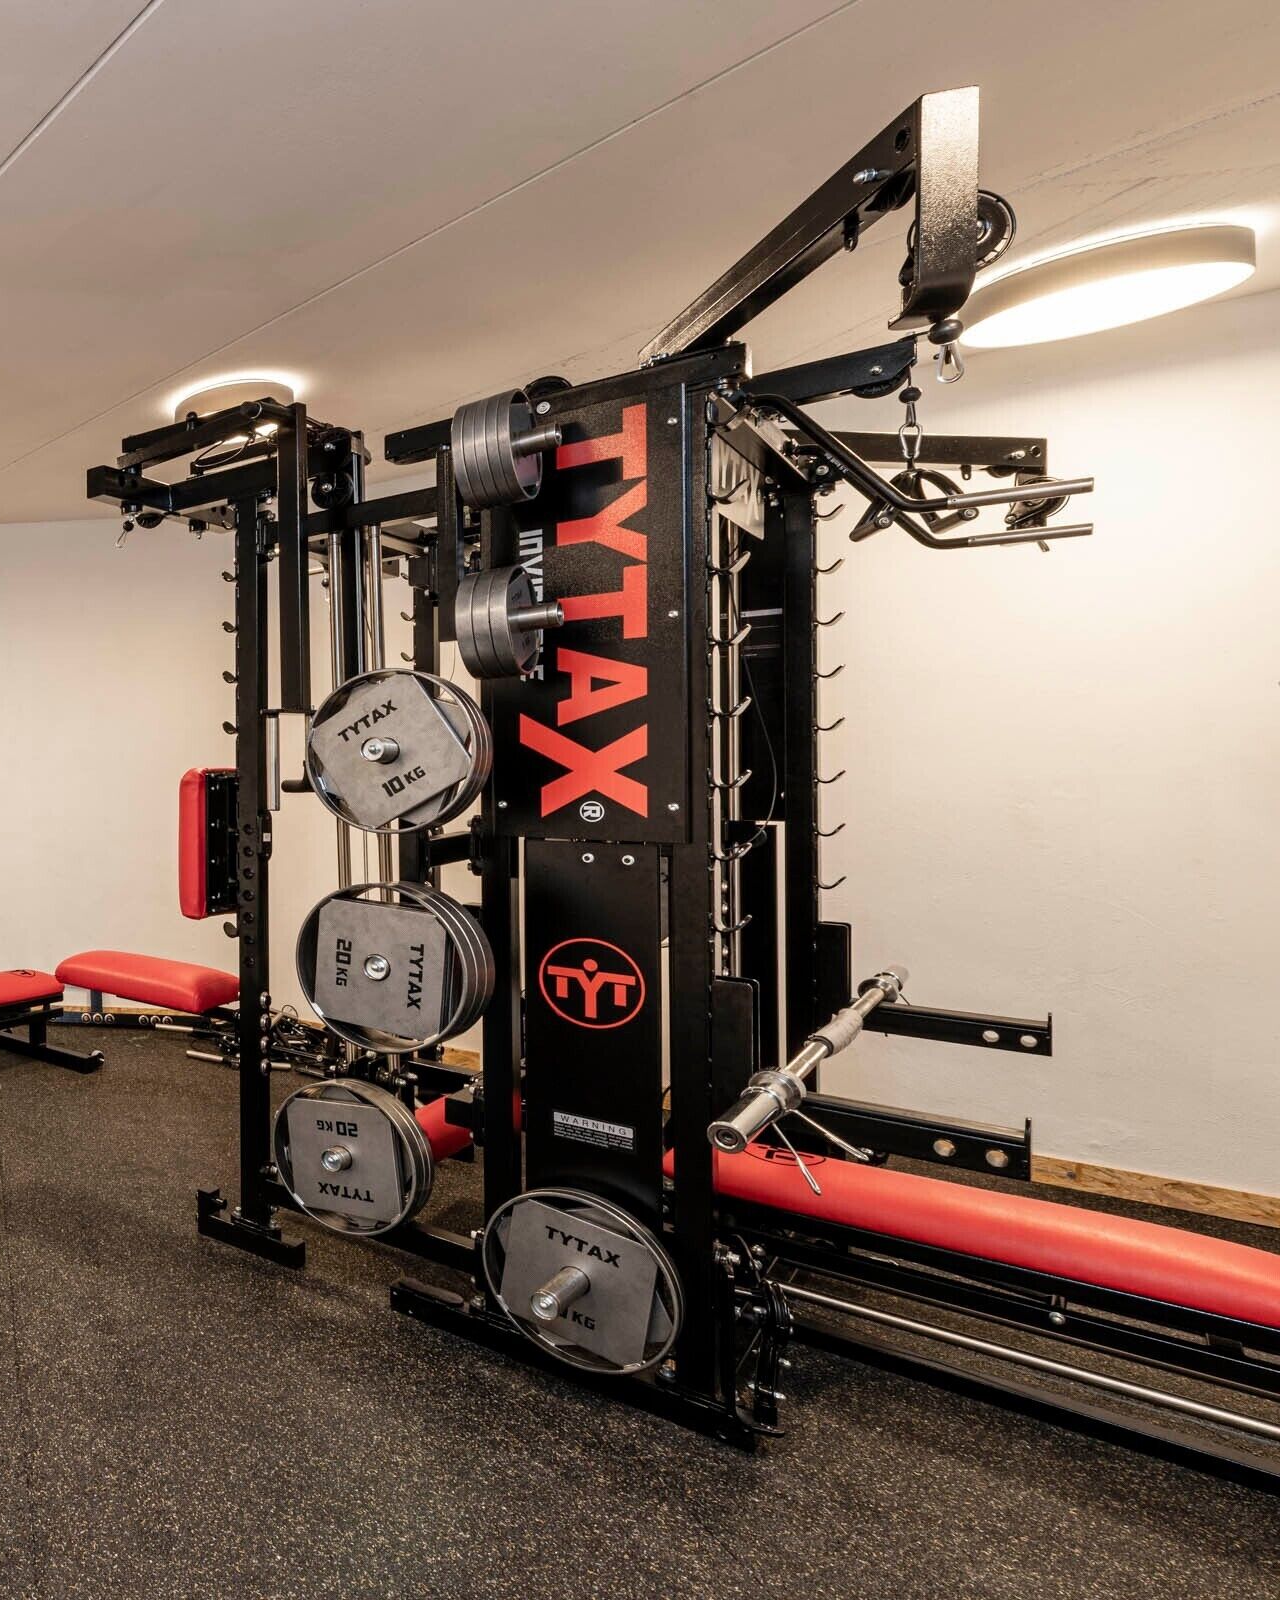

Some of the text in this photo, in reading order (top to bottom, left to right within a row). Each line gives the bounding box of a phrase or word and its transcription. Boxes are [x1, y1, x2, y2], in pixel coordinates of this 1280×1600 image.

[720, 439, 760, 526] YTAX
[337, 699, 398, 742] TYTAX
[382, 766, 426, 797] 10 KG
[335, 938, 352, 987] 20 KG
[407, 944, 425, 1010] TYTAX
[316, 1120, 358, 1137] 20 KG
[560, 1114, 627, 1136] WARNING
[318, 1181, 375, 1203] TYTAX
[545, 1225, 621, 1268] TYTAX
[572, 1311, 596, 1331] KG
